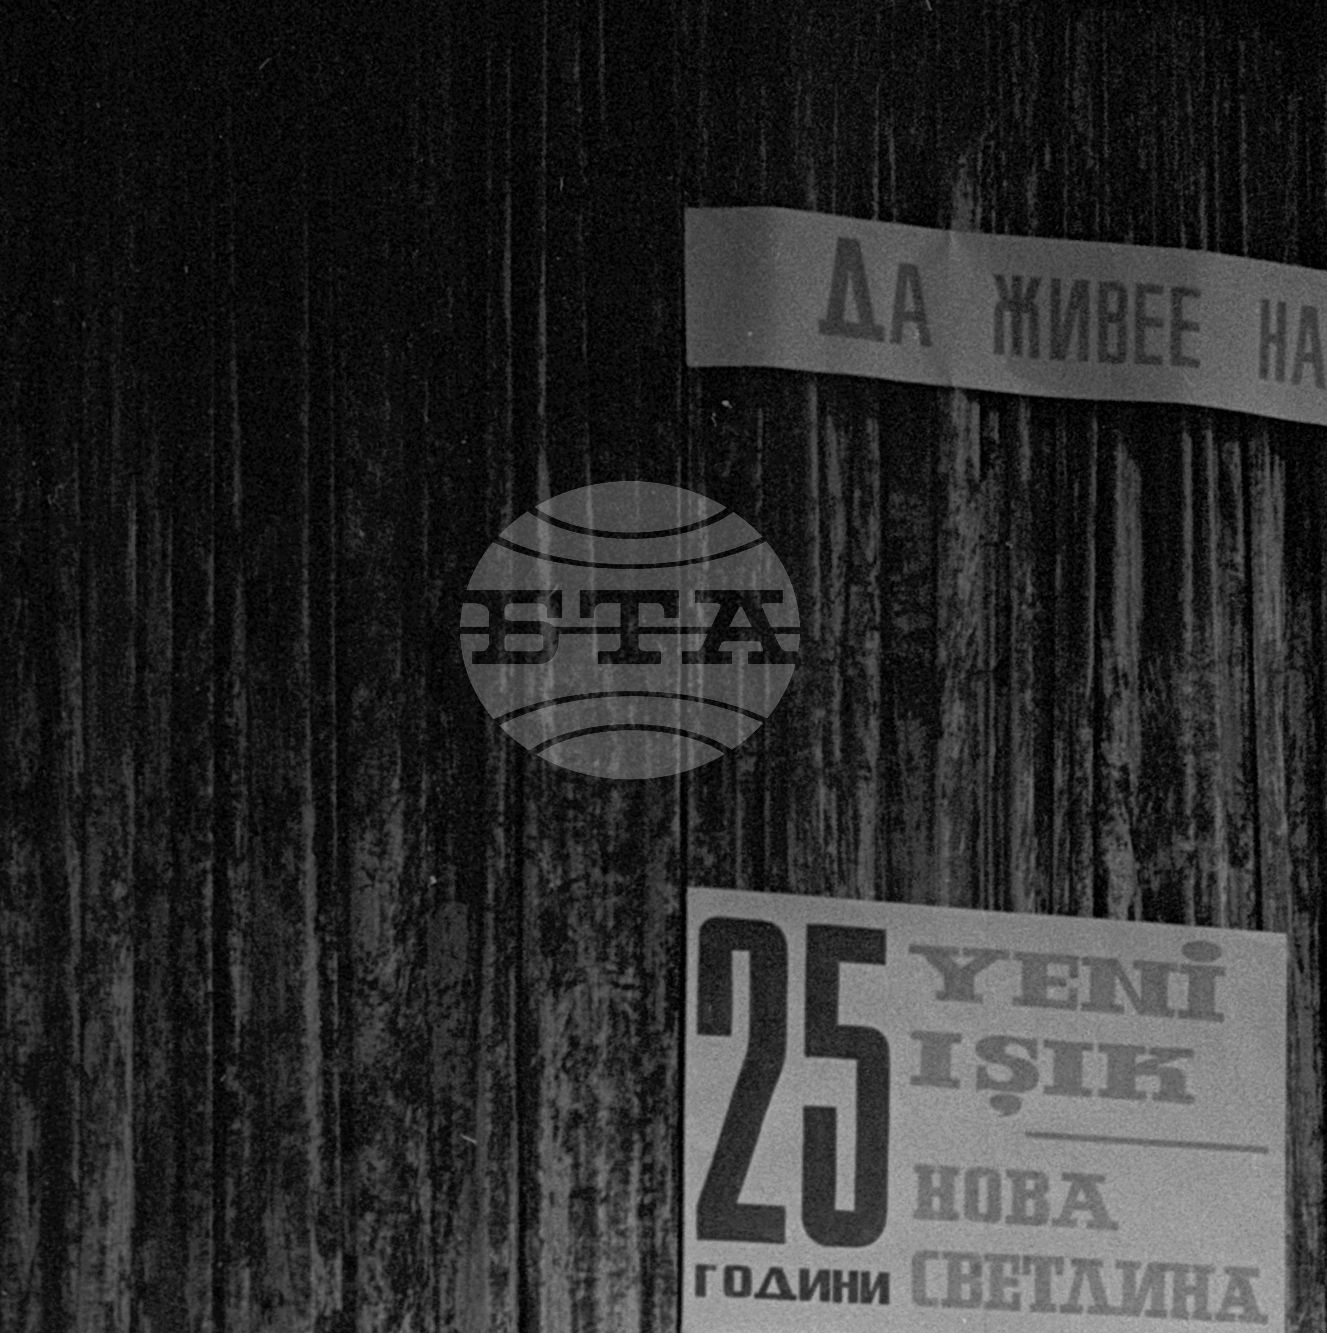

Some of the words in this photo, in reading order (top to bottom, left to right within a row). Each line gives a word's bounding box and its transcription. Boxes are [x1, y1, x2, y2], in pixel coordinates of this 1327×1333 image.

[818, 236, 933, 348] ДА
[994, 273, 1202, 369] ЖИВЕЕ
[908, 939, 1226, 1024] YENİ
[696, 916, 891, 1248] 25
[909, 1030, 1196, 1117] IŞIK
[912, 1163, 1119, 1231] НОВА
[694, 1263, 891, 1305] ГОДИНИ
[910, 1249, 1269, 1325] СВЕТЛИНА
